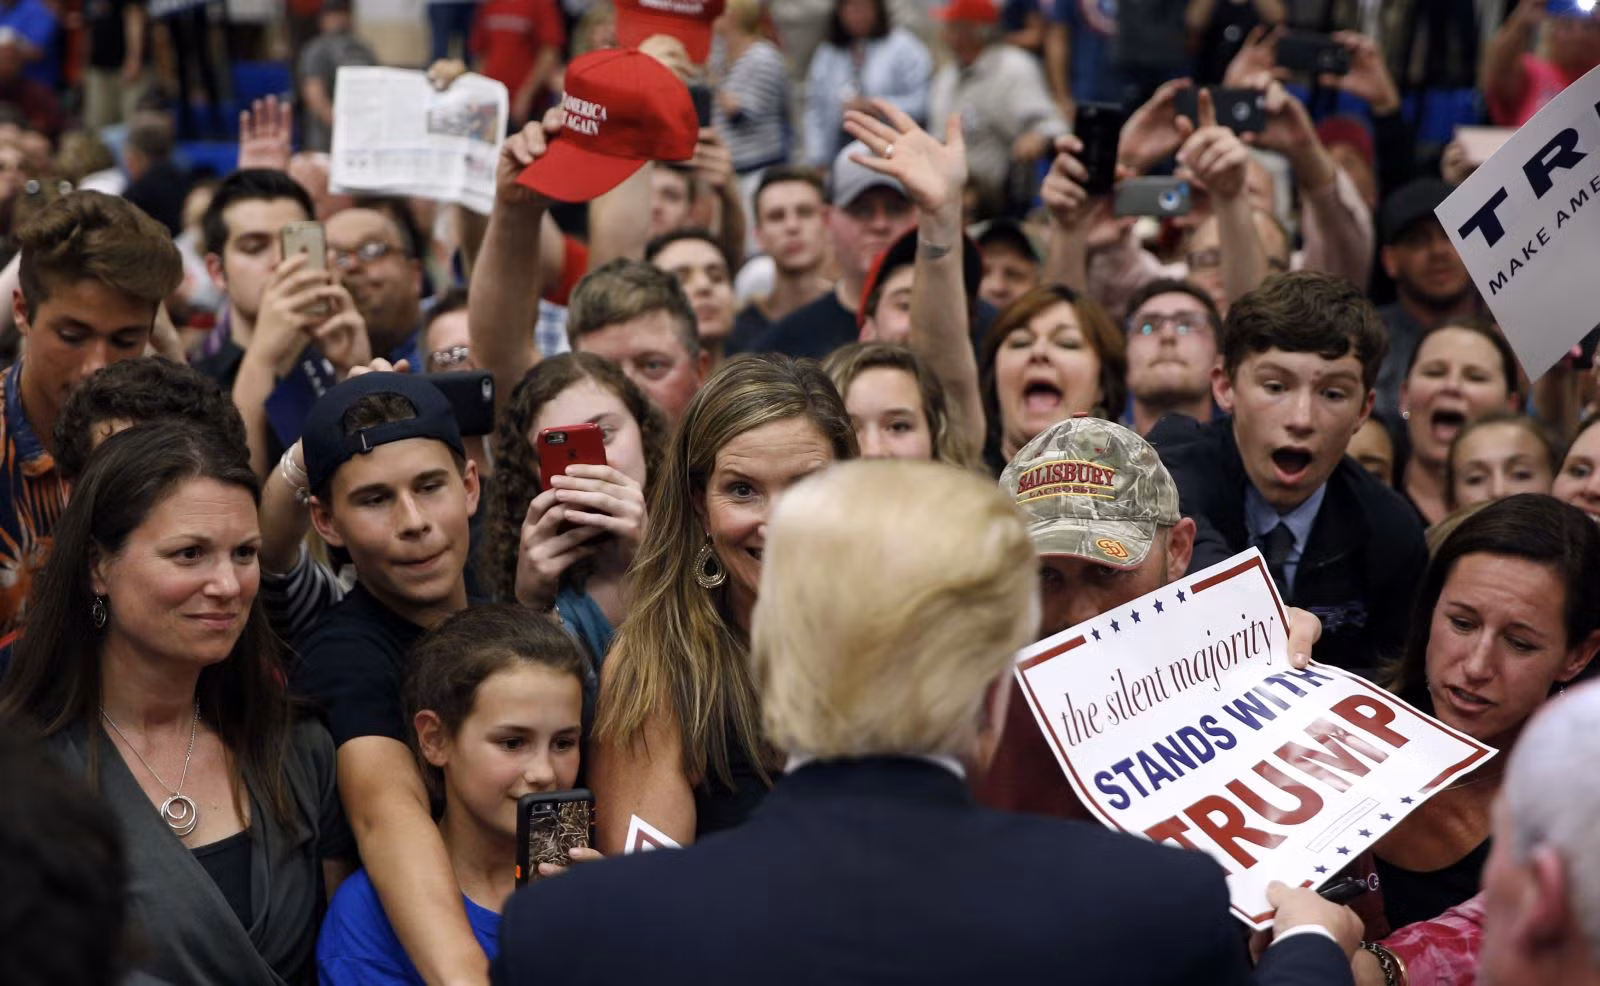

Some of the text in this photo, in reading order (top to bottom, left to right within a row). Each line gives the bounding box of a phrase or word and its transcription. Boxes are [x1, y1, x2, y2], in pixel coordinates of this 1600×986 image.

[1457, 100, 1600, 248] TR
[1488, 227, 1550, 295] MAKE
[1017, 462, 1115, 494] SALISBURY
[1029, 485, 1098, 498] LACROSSE
[1061, 692, 1103, 746] the
[1105, 668, 1170, 725] silent
[1168, 613, 1274, 692] majority
[1094, 668, 1335, 810] STANDS WITH
